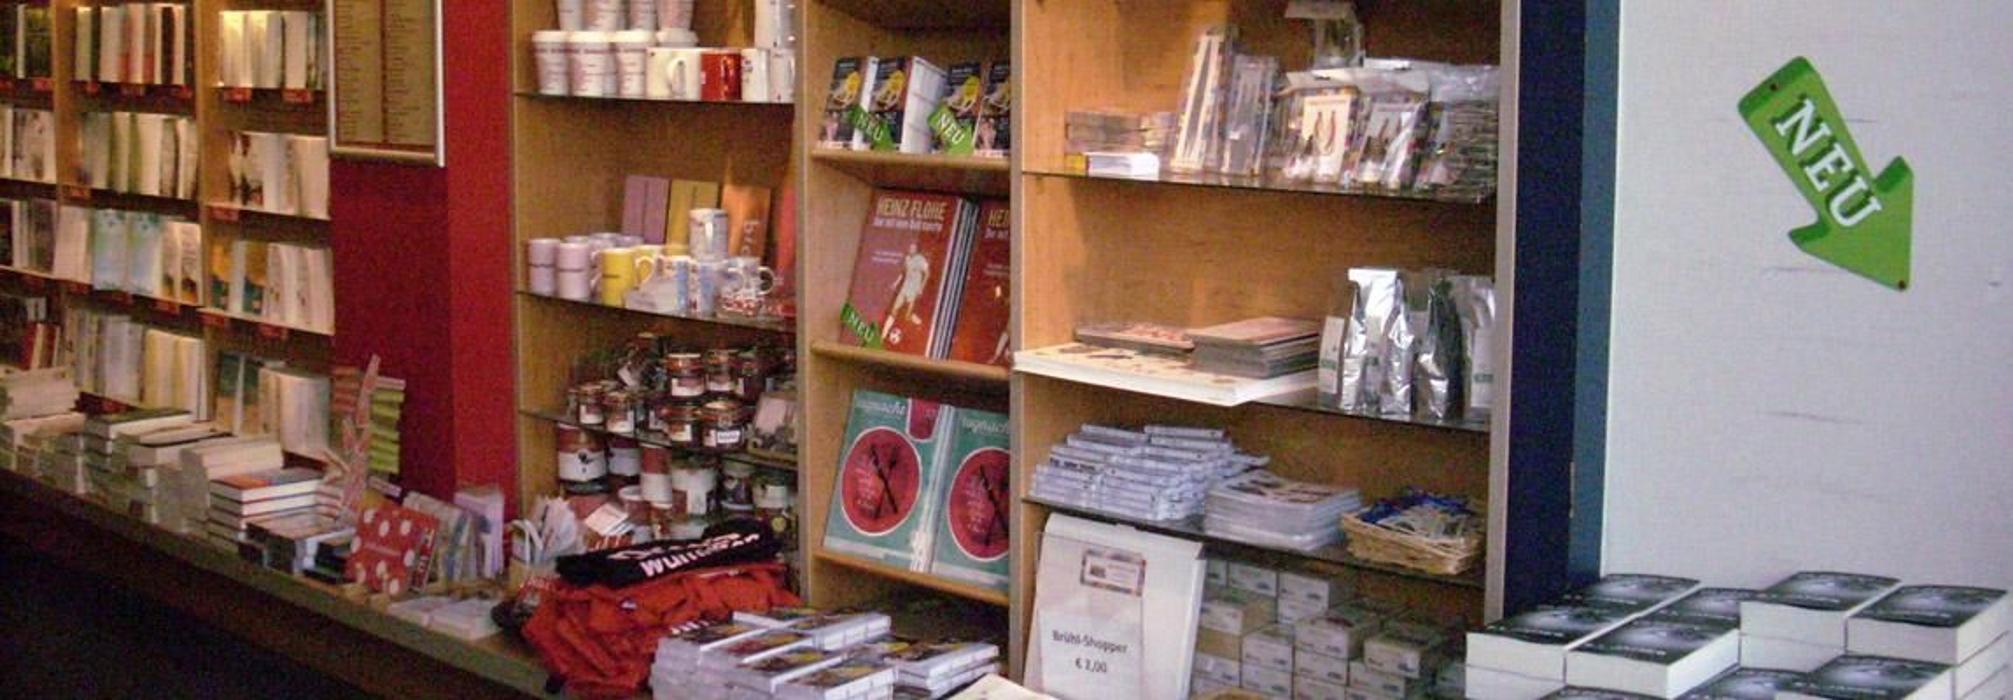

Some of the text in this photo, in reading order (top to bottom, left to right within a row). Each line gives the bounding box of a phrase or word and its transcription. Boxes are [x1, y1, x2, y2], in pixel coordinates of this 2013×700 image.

[938, 113, 966, 144] NEU
[1775, 98, 1882, 227] NEU
[876, 197, 910, 218] HEINZ
[847, 311, 874, 342] NEU
[1052, 630, 1128, 653] Brühl-Shopper
[1075, 657, 1083, 669] €
